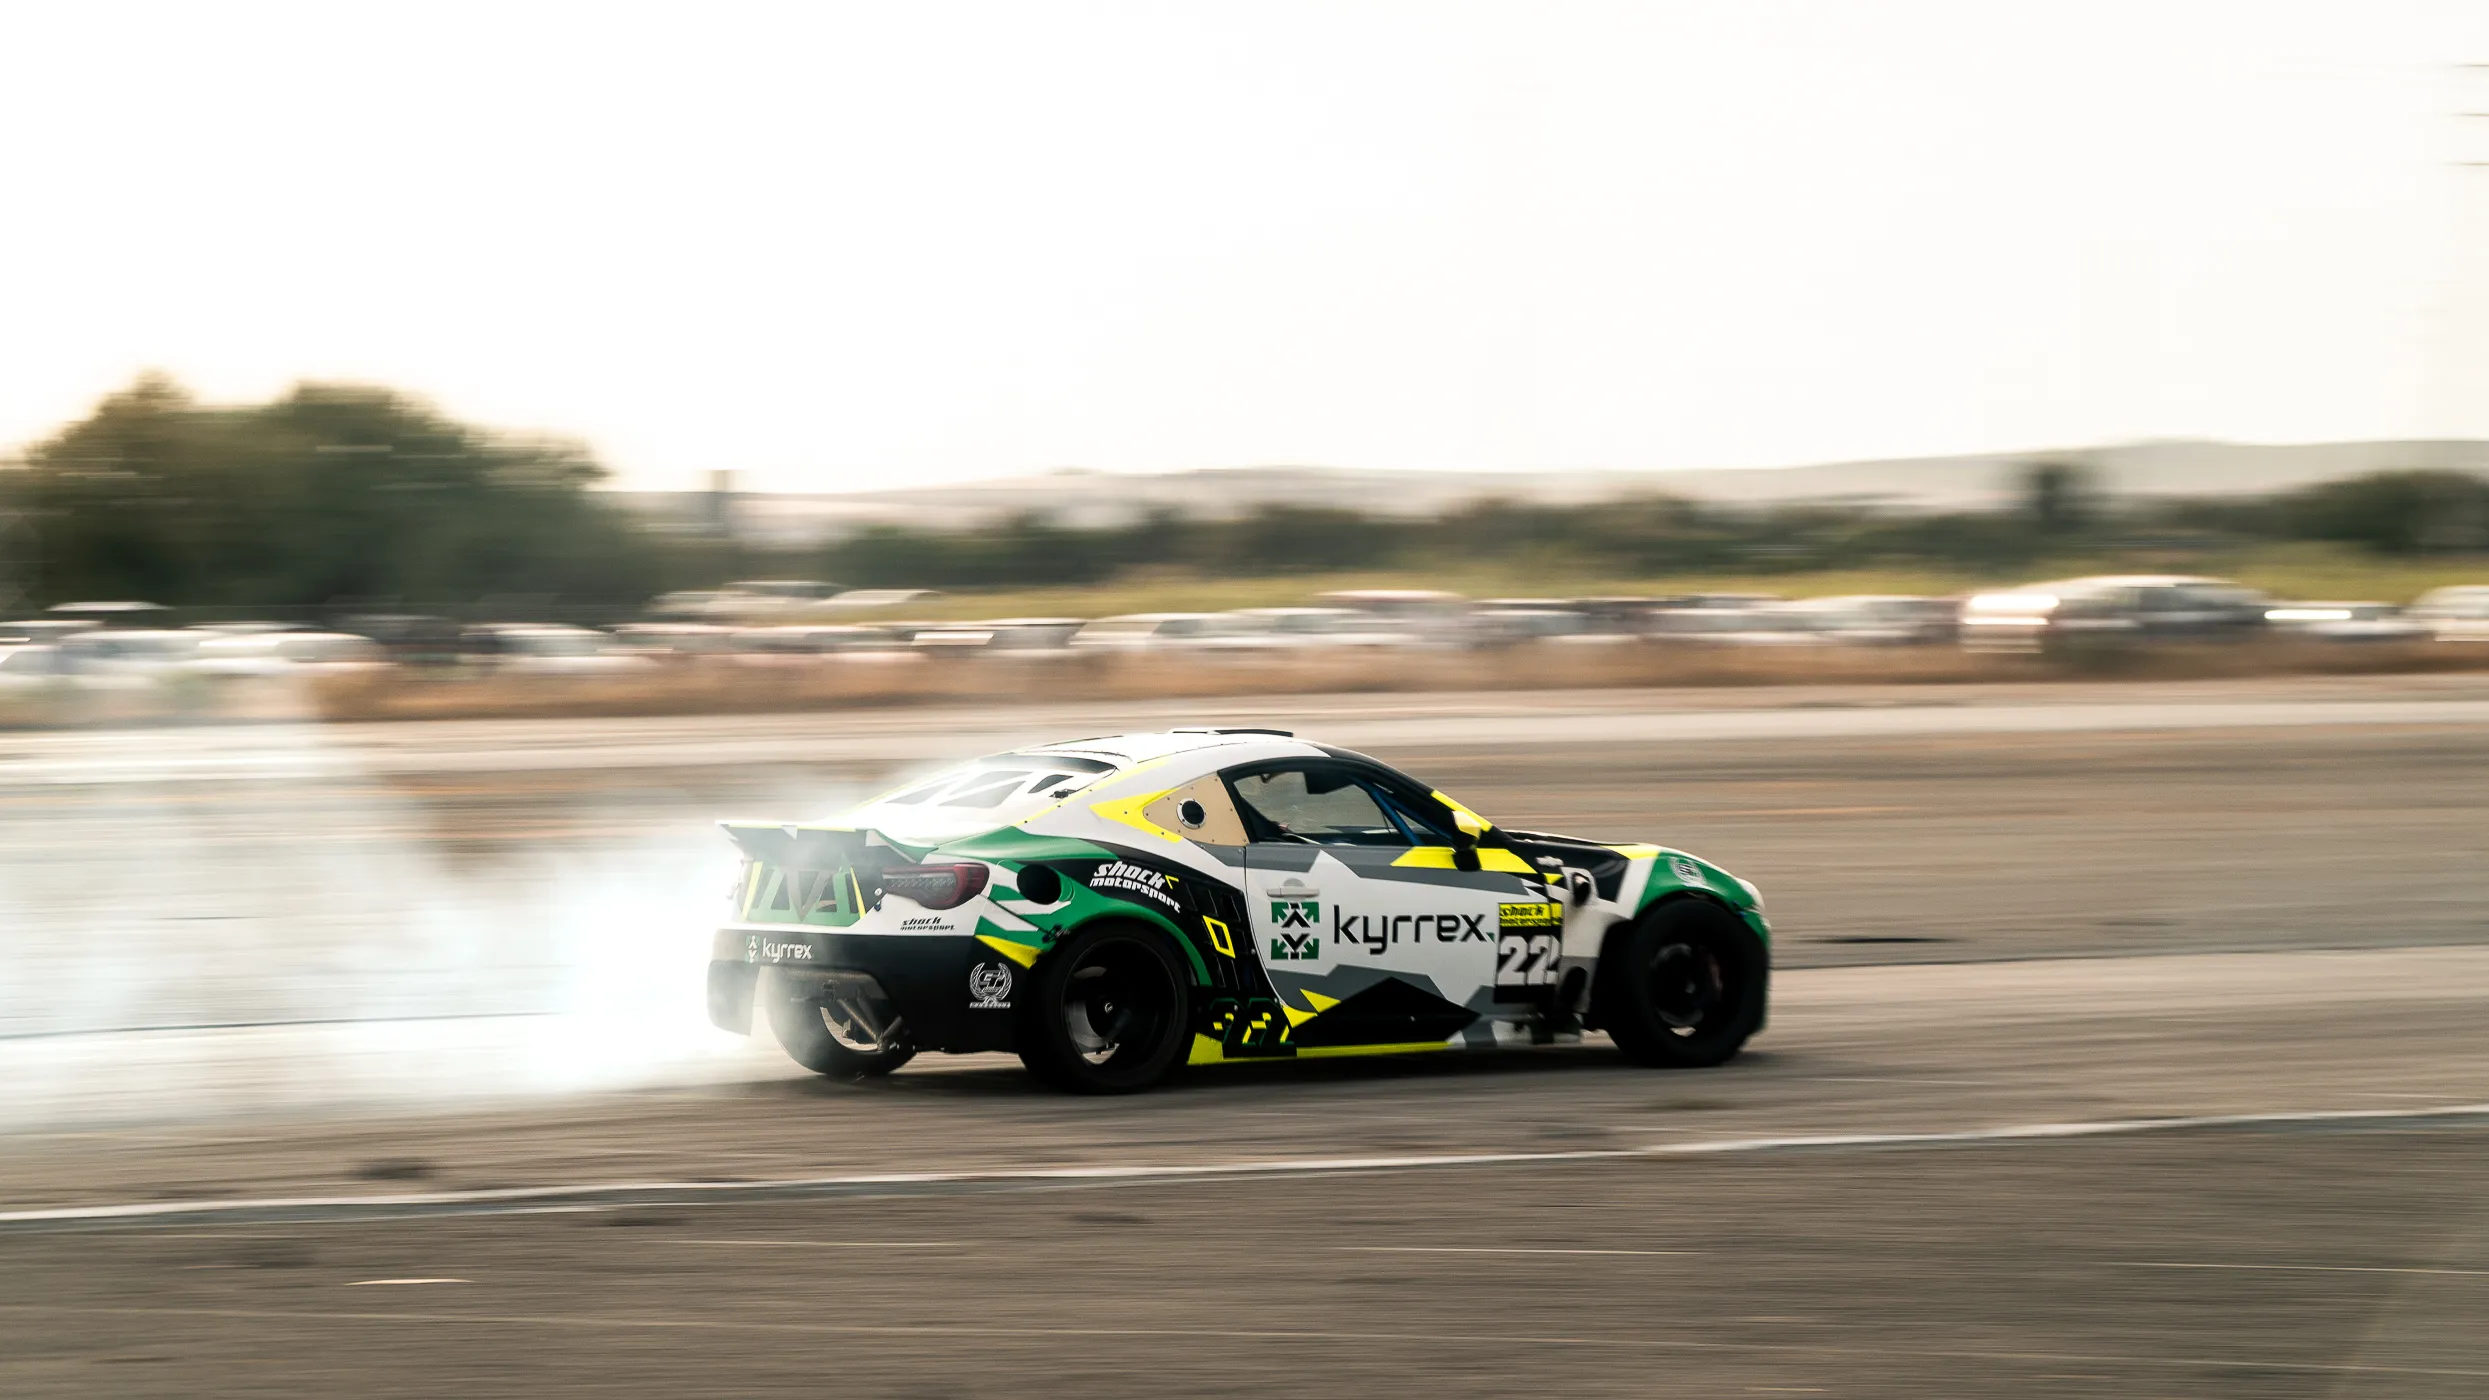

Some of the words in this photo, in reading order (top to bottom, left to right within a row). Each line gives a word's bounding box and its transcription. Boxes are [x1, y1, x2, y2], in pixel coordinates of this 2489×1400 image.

[1093, 861, 1166, 890] shock
[1089, 877, 1181, 914] motorsport
[1333, 904, 1487, 956] kyrrex
[762, 937, 813, 963] kyrrex
[1497, 935, 1560, 986] 22
